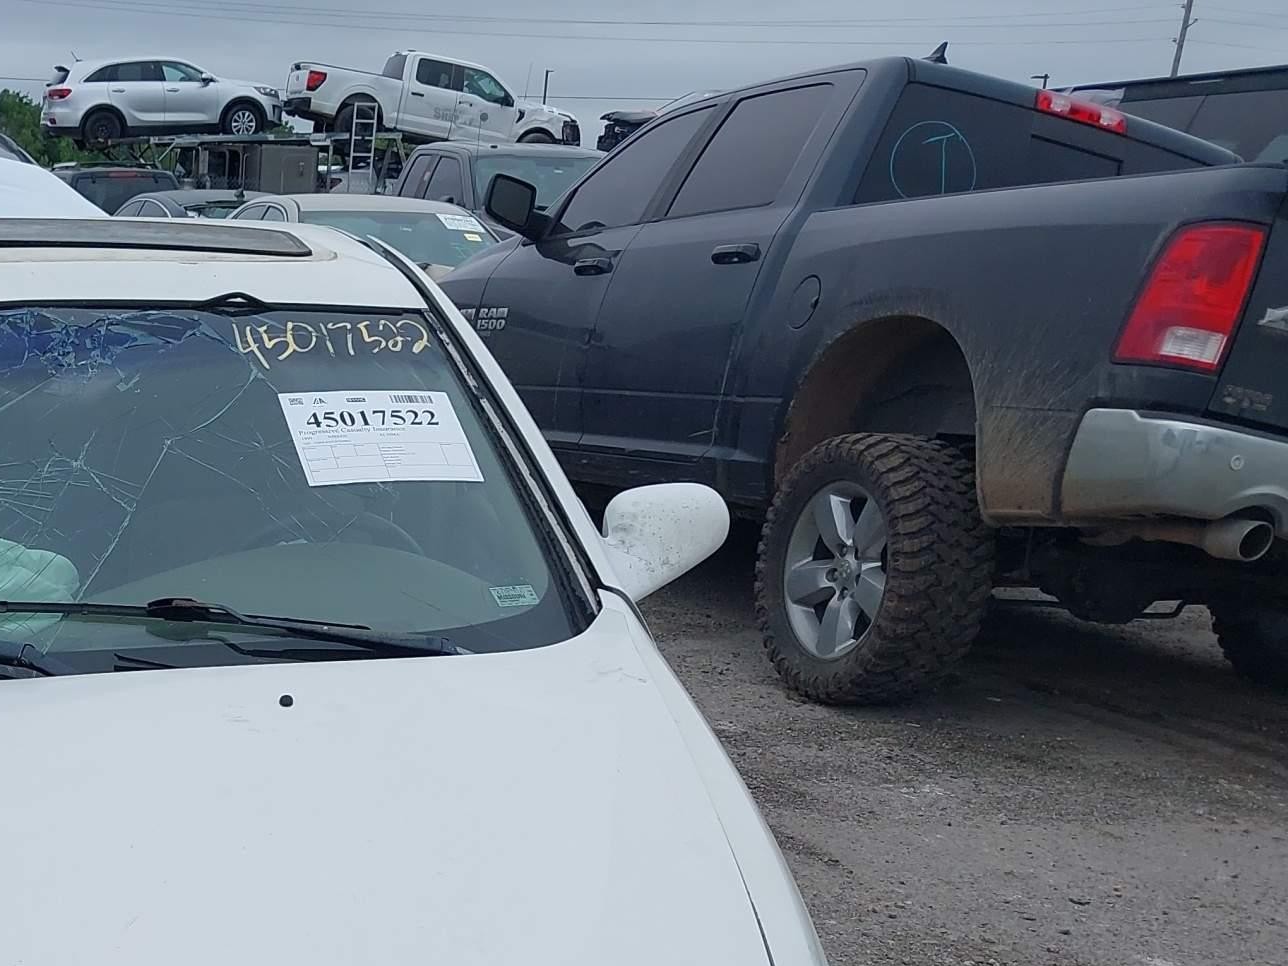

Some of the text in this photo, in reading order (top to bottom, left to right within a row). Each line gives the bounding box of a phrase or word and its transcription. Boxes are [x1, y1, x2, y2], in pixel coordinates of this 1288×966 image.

[479, 307, 509, 318] RAM
[476, 319, 506, 330] 1500
[232, 319, 431, 370] 45017522
[306, 409, 440, 428] 45017522
